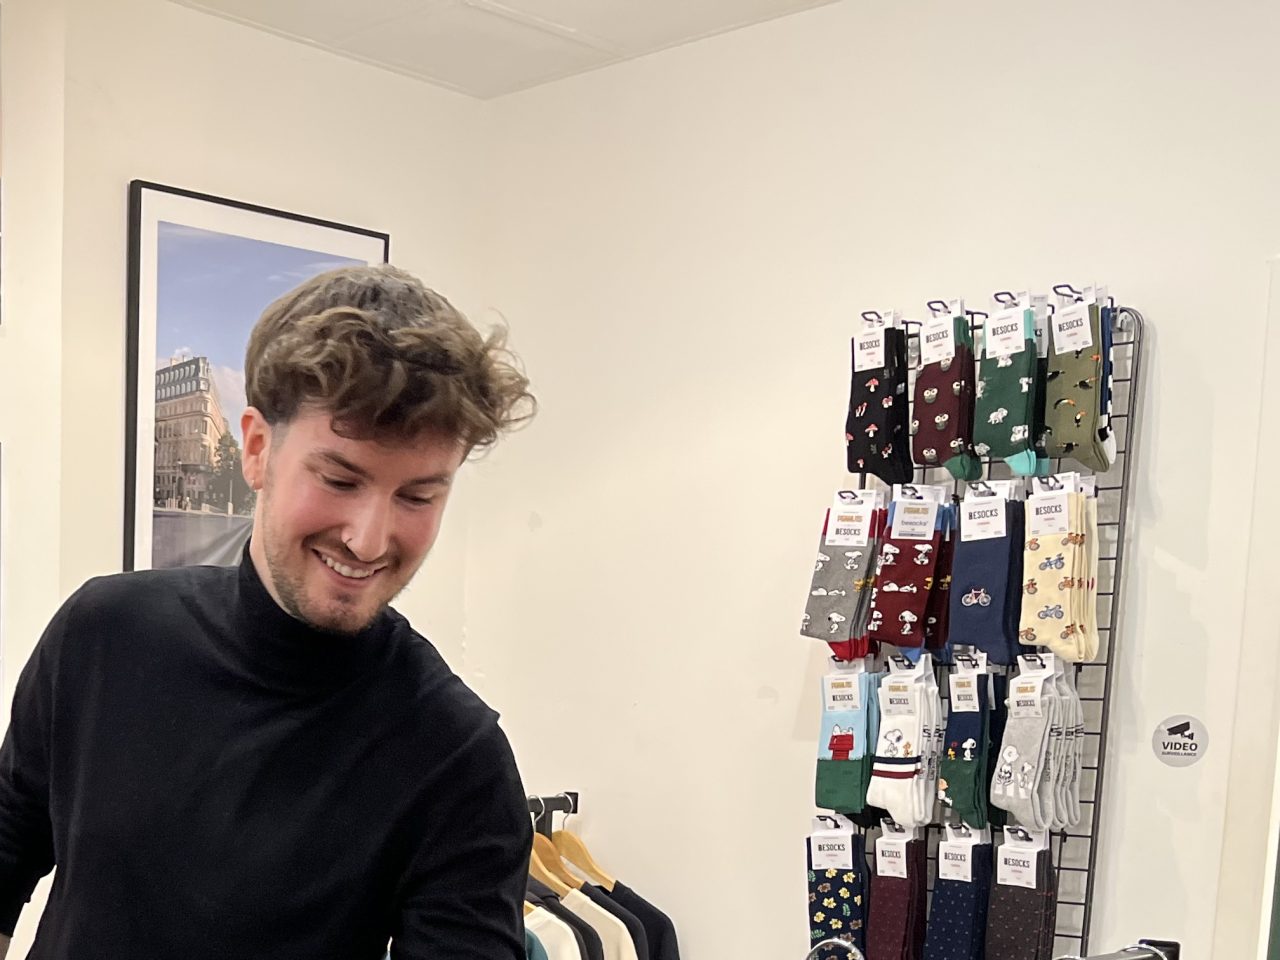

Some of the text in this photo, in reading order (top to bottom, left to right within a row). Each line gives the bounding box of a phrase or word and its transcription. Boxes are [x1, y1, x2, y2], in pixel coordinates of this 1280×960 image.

[991, 322, 1019, 336] BESOCKS
[1058, 318, 1084, 332] BESOCKS
[925, 329, 949, 343] BESOCKS
[859, 339, 881, 351] BESOCKS
[968, 508, 999, 520] BESOCKS
[1035, 504, 1063, 516] BESOCKS
[835, 528, 861, 536] BESOCKS
[1162, 741, 1198, 751] VIDEO
[818, 843, 846, 852] BESOCKS
[881, 849, 902, 859] BESOCKS
[944, 852, 967, 862] BESOCKS
[1003, 857, 1031, 869] BESOCKS
